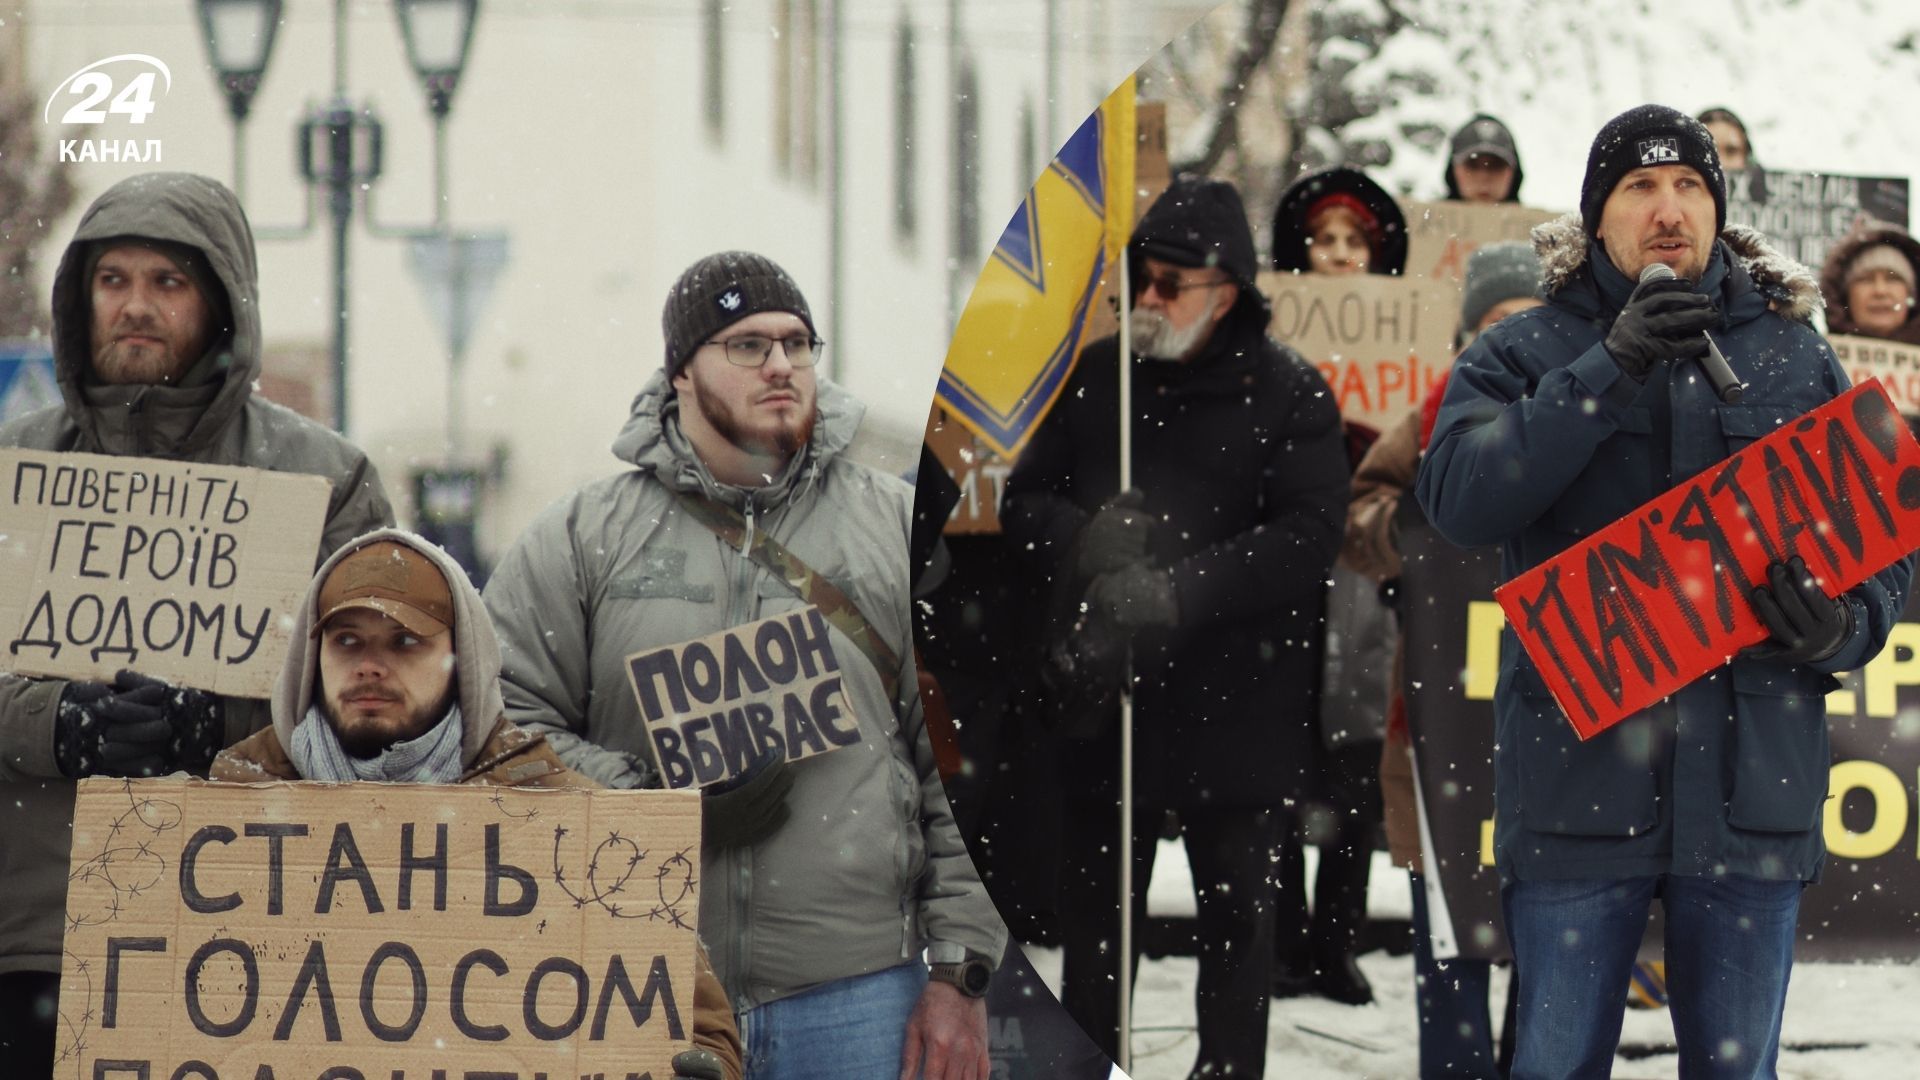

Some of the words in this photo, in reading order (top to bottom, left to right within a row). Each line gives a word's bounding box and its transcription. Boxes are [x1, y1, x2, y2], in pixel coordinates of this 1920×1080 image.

[1272, 289, 1420, 343] ОЛОНІ
[14, 461, 249, 523] ПОВЕРНІТЬ
[50, 520, 237, 589] ГЕРОЇВ
[10, 590, 272, 664] ДОДОМУ
[630, 607, 840, 722] ПОЛОН
[652, 676, 862, 790] ВБИВАЄ
[179, 822, 540, 917] СТАНЬ
[101, 936, 687, 1042] ГОЛОСОМ
